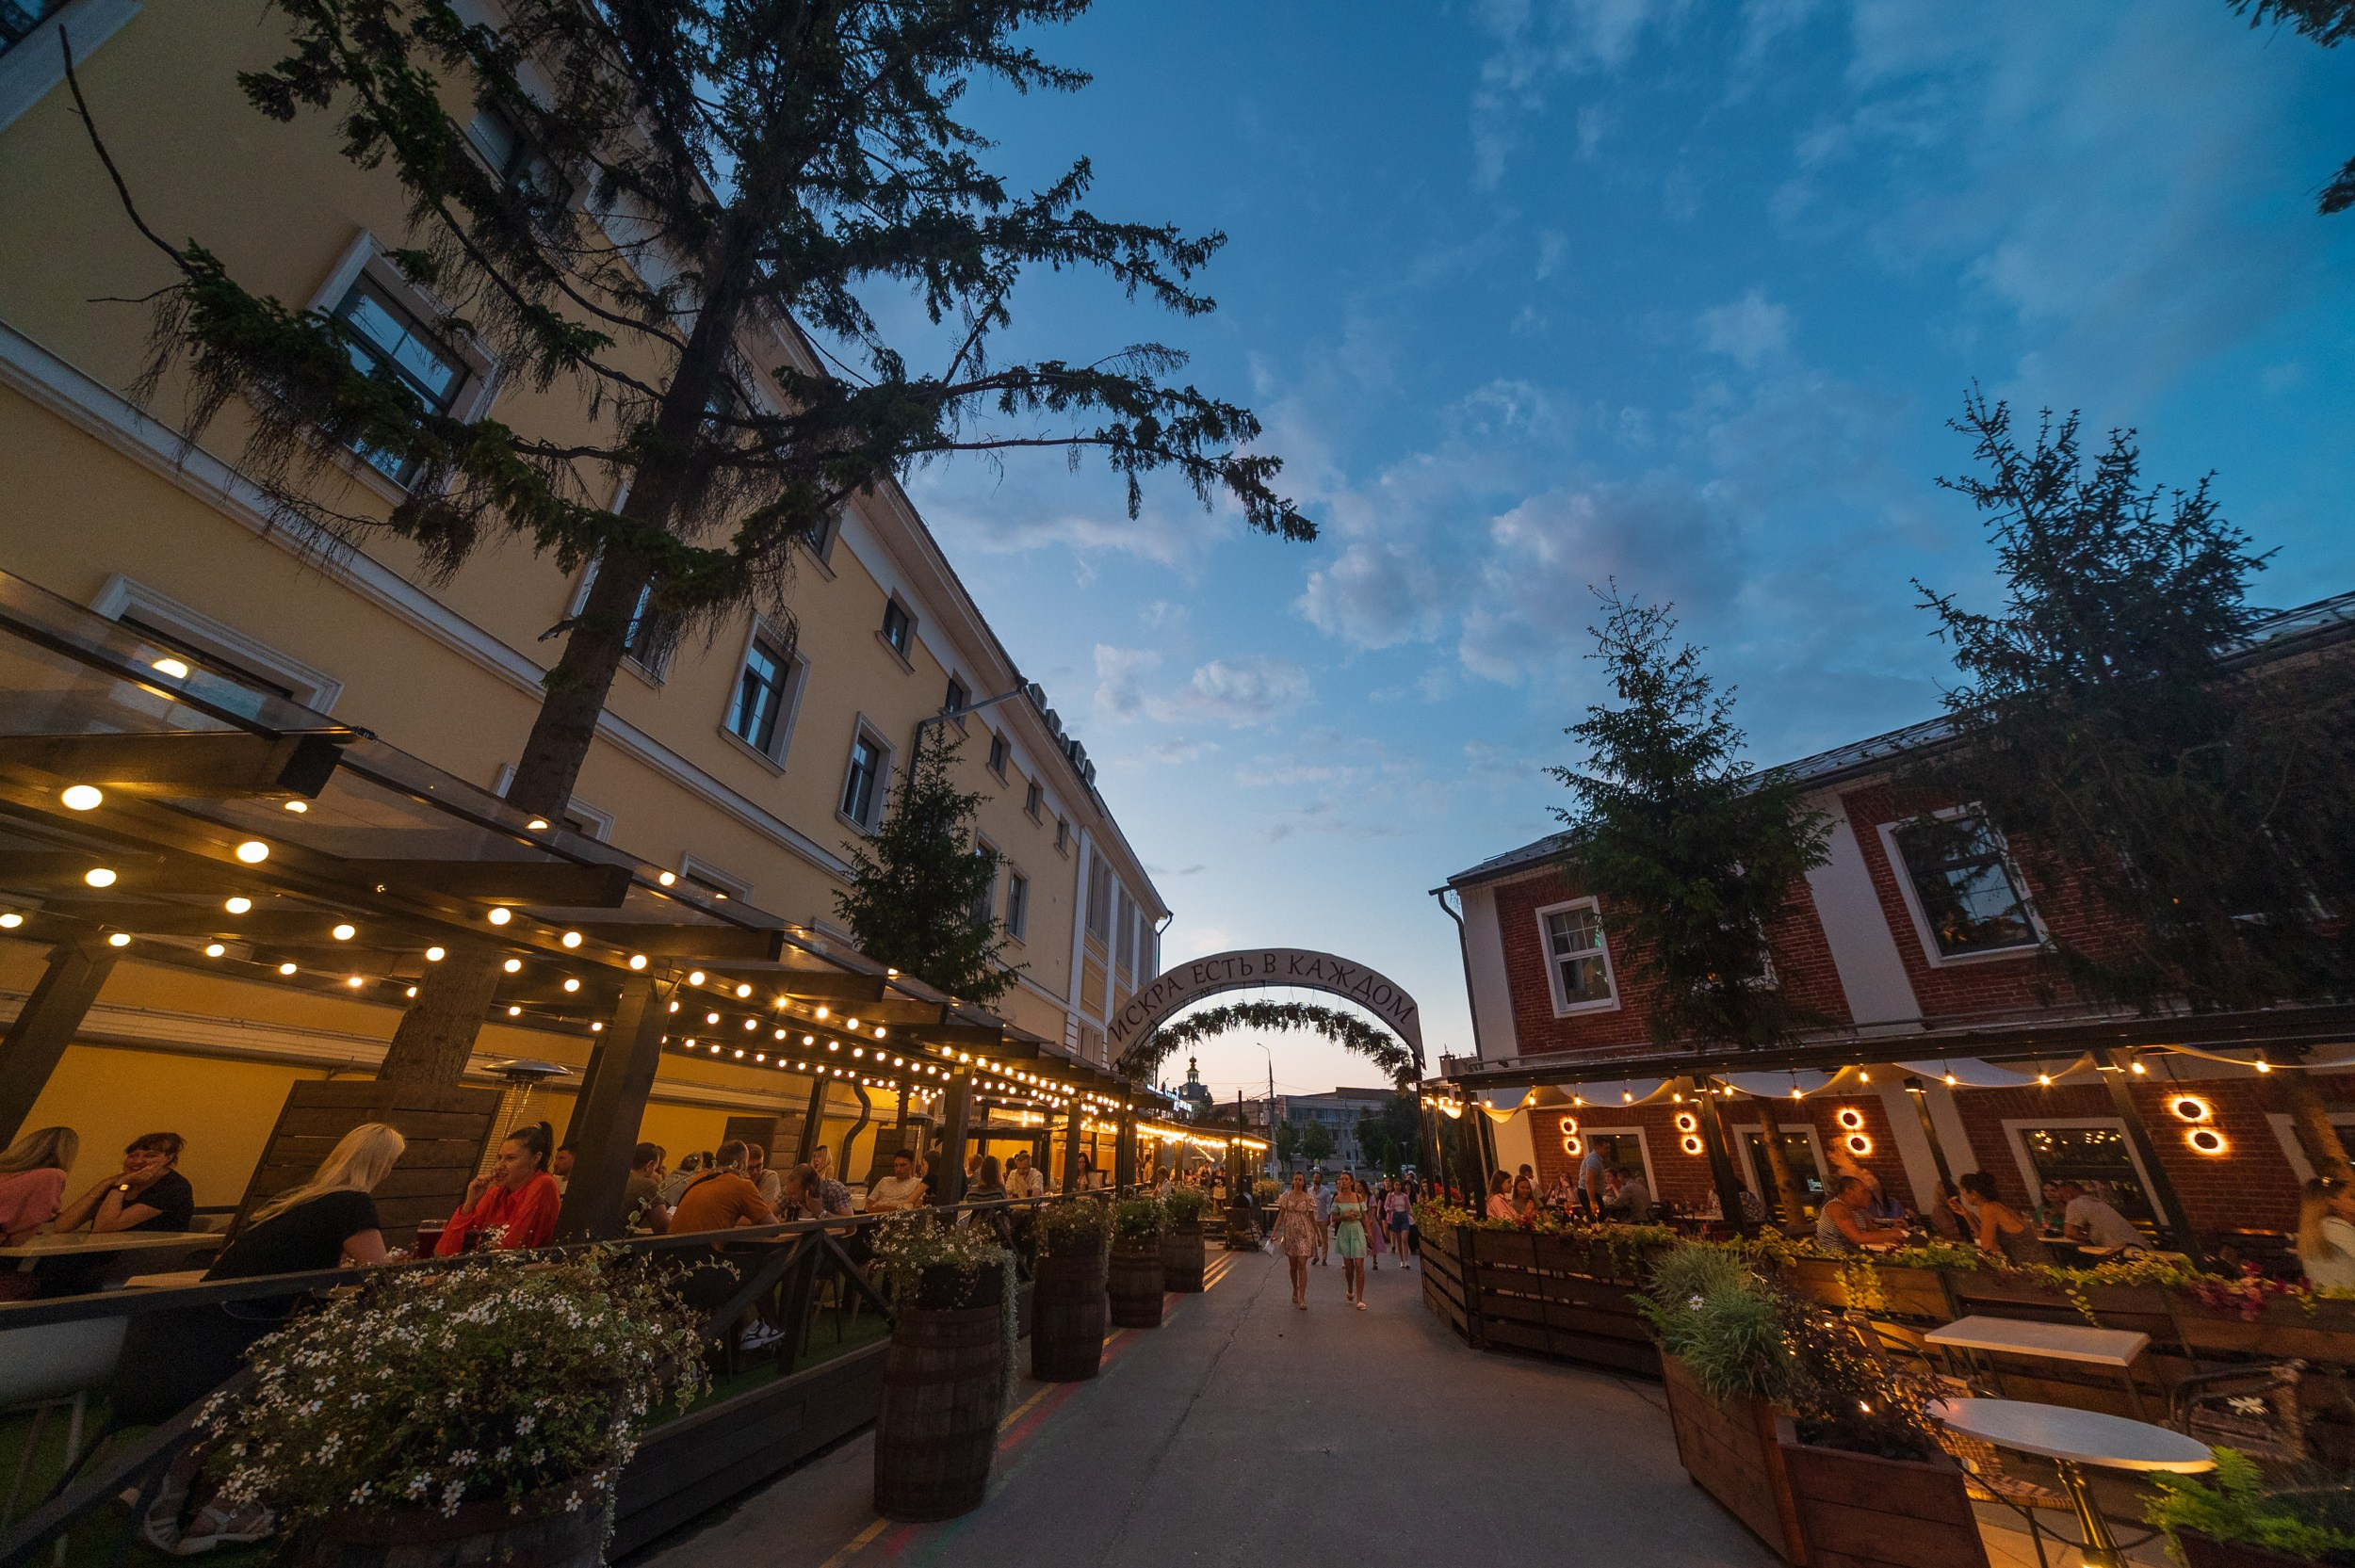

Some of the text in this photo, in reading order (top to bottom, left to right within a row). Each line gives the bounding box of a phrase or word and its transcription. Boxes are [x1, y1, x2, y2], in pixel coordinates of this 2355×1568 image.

[1110, 953, 1416, 1042] ИСКРА ЕСТЬ В КАЖДОМ
